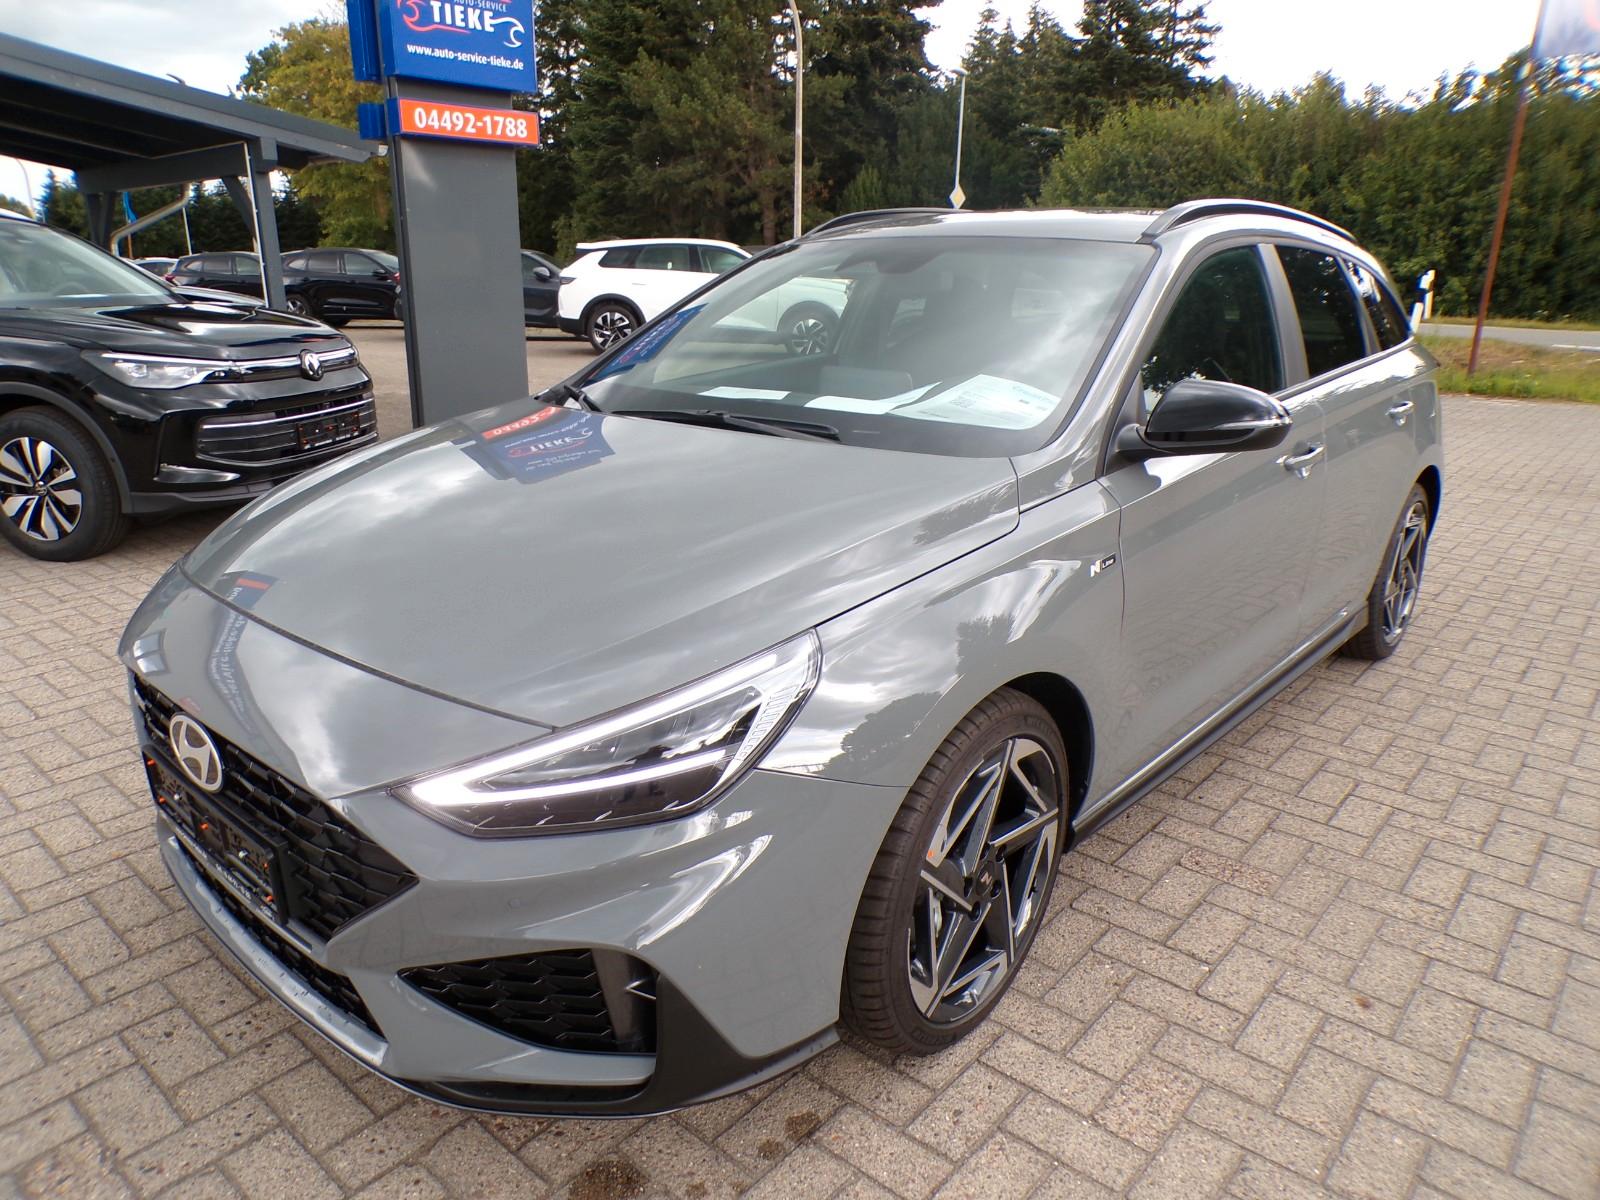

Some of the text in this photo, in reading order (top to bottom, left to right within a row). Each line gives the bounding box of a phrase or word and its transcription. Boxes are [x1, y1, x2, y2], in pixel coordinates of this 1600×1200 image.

[430, 1, 495, 32] TIEKE
[407, 43, 524, 70] www.auto-service-tieke.de
[414, 107, 528, 138] 04492-1788
